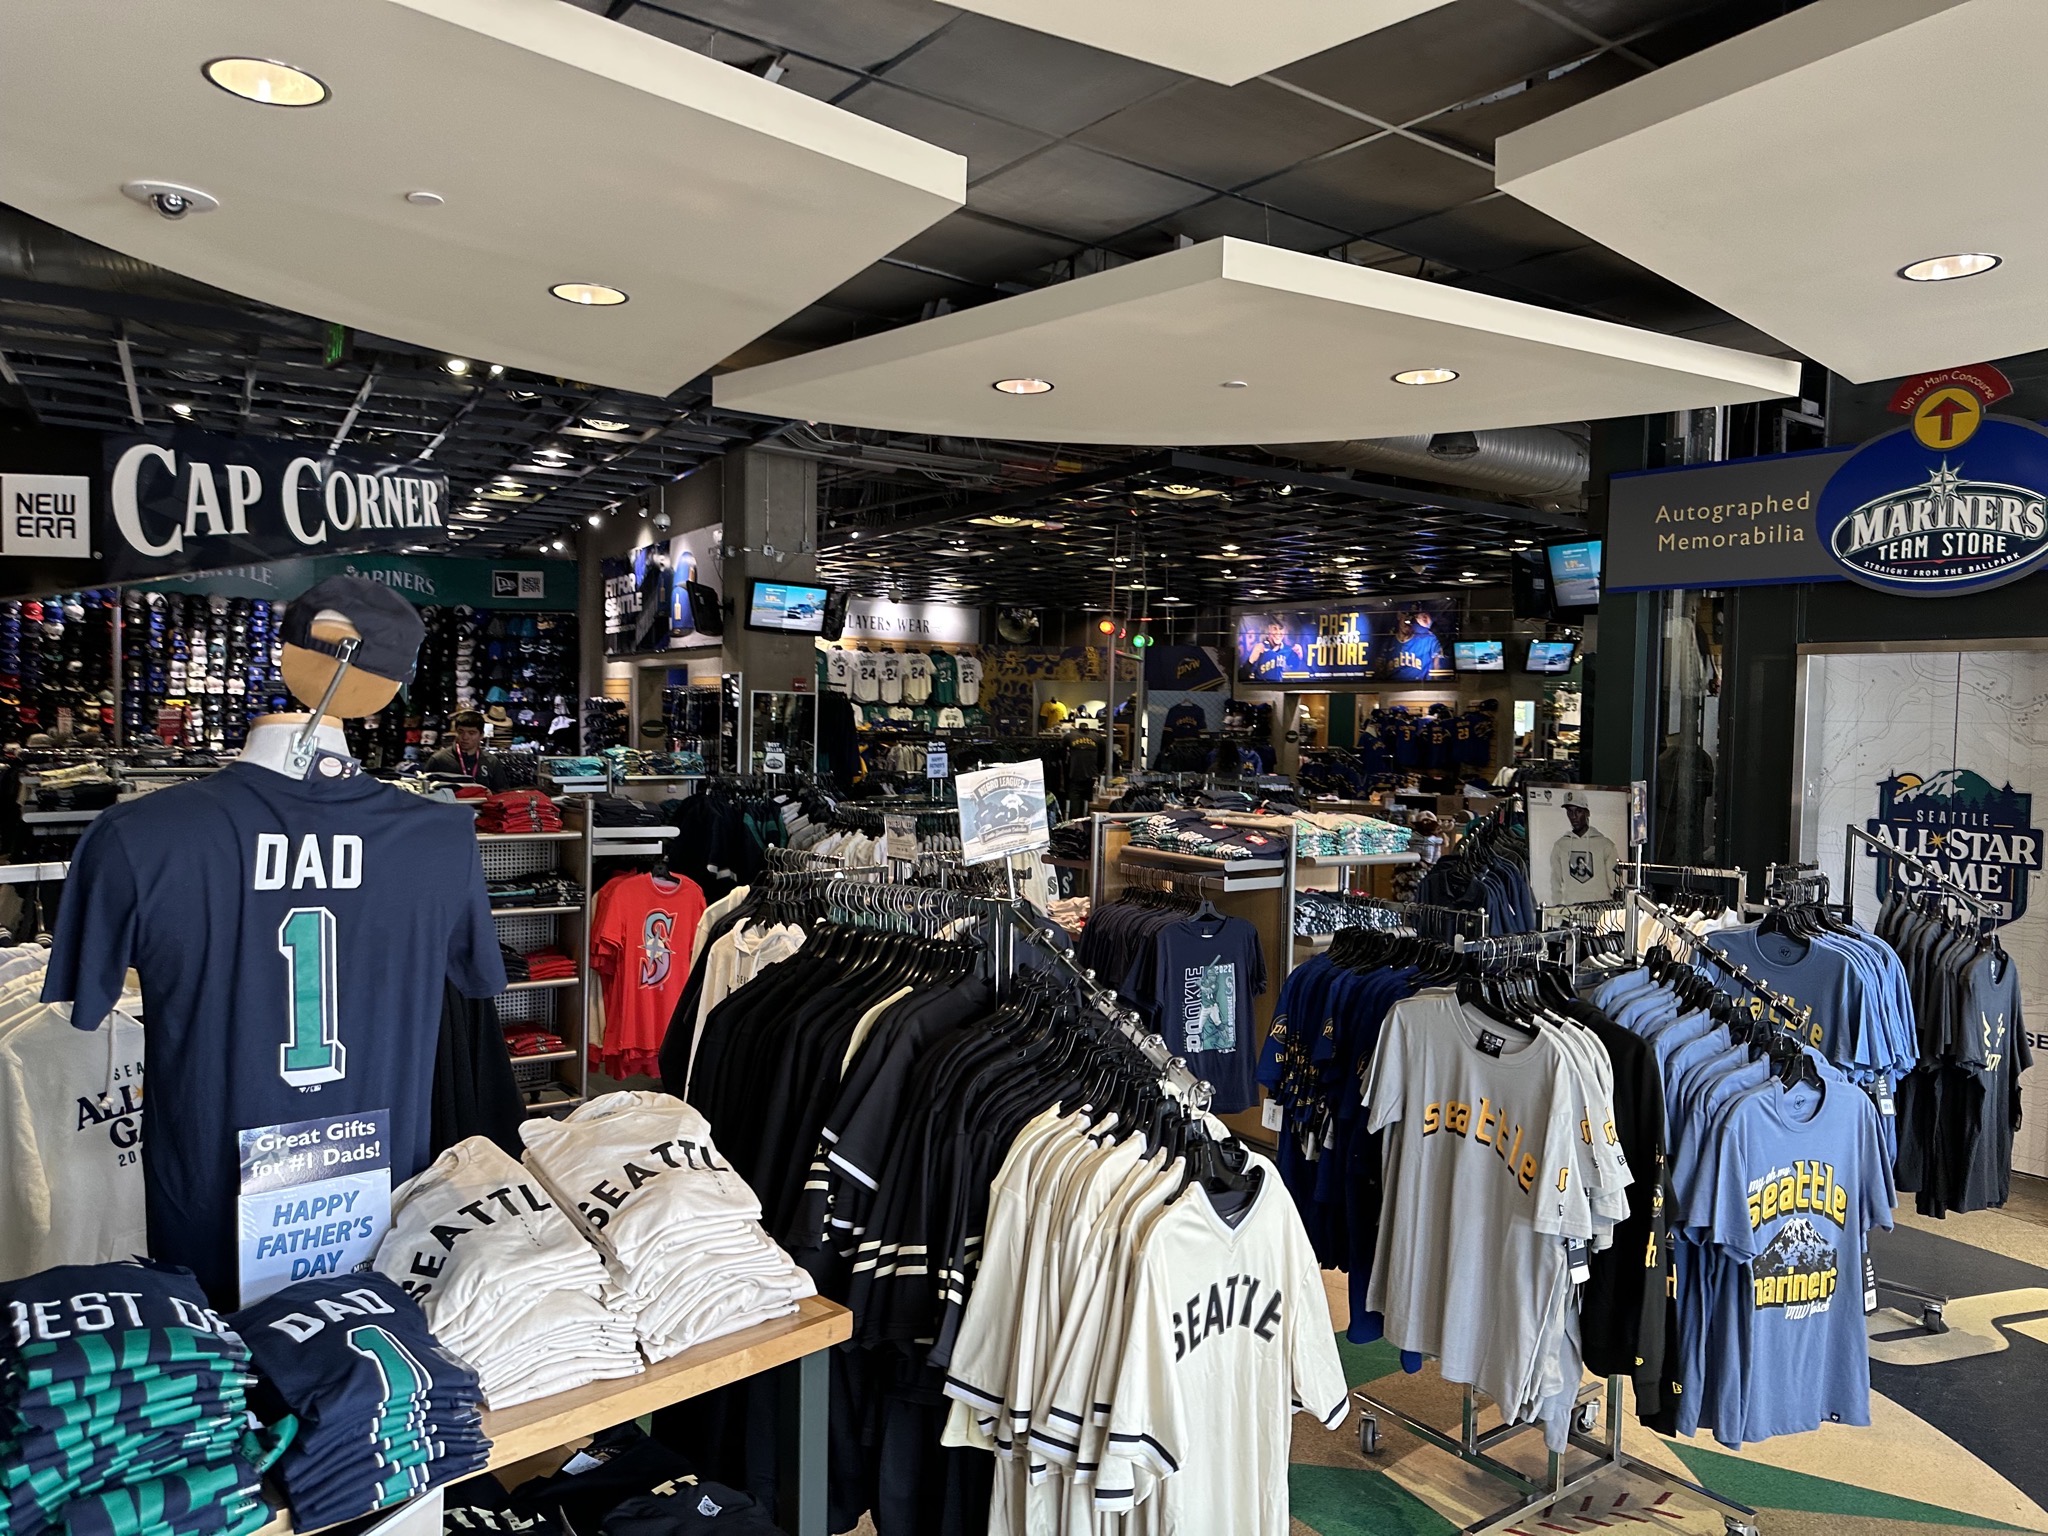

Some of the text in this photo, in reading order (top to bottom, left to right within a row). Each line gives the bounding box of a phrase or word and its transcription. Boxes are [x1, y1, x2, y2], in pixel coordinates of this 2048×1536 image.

[1900, 370, 1996, 410] Up to Main Concourse
[16, 492, 76, 515] NEW
[282, 456, 442, 546] CORNER
[1655, 490, 1810, 524] Autographed
[16, 516, 77, 539] ERA
[1658, 524, 1805, 552] Memorabilia
[1850, 495, 2046, 552] MARINERS
[1878, 532, 2007, 561] TEAM STORE
[1864, 552, 2021, 577] STRAIGHT FROM THE BALLPARK
[848, 614, 930, 634] LAYERS WEAR
[1319, 612, 1360, 636] PAST
[1307, 642, 1369, 667] FUTURE
[861, 667, 876, 681] 24
[911, 666, 925, 680] 24
[977, 778, 999, 797] NEGRO
[999, 775, 1027, 790] LEAGUES
[1916, 809, 1989, 827] SEATTLE
[253, 833, 363, 891] DAD
[1945, 828, 2038, 866] STAR
[278, 906, 346, 1087] 1
[1184, 966, 1205, 1054] ROOKIE
[256, 1120, 376, 1152] Great Gifts
[1423, 1096, 1538, 1196] seattle
[251, 1140, 381, 1179] for #1 Dads!
[578, 1138, 728, 1231] SEATTL
[1747, 1159, 1848, 1232] seattle
[272, 1190, 360, 1227] HAPPY
[256, 1215, 374, 1259] FATHER'S
[401, 1184, 552, 1303] SEATTL
[291, 1249, 344, 1281] DAY
[268, 1288, 396, 1343] DAD
